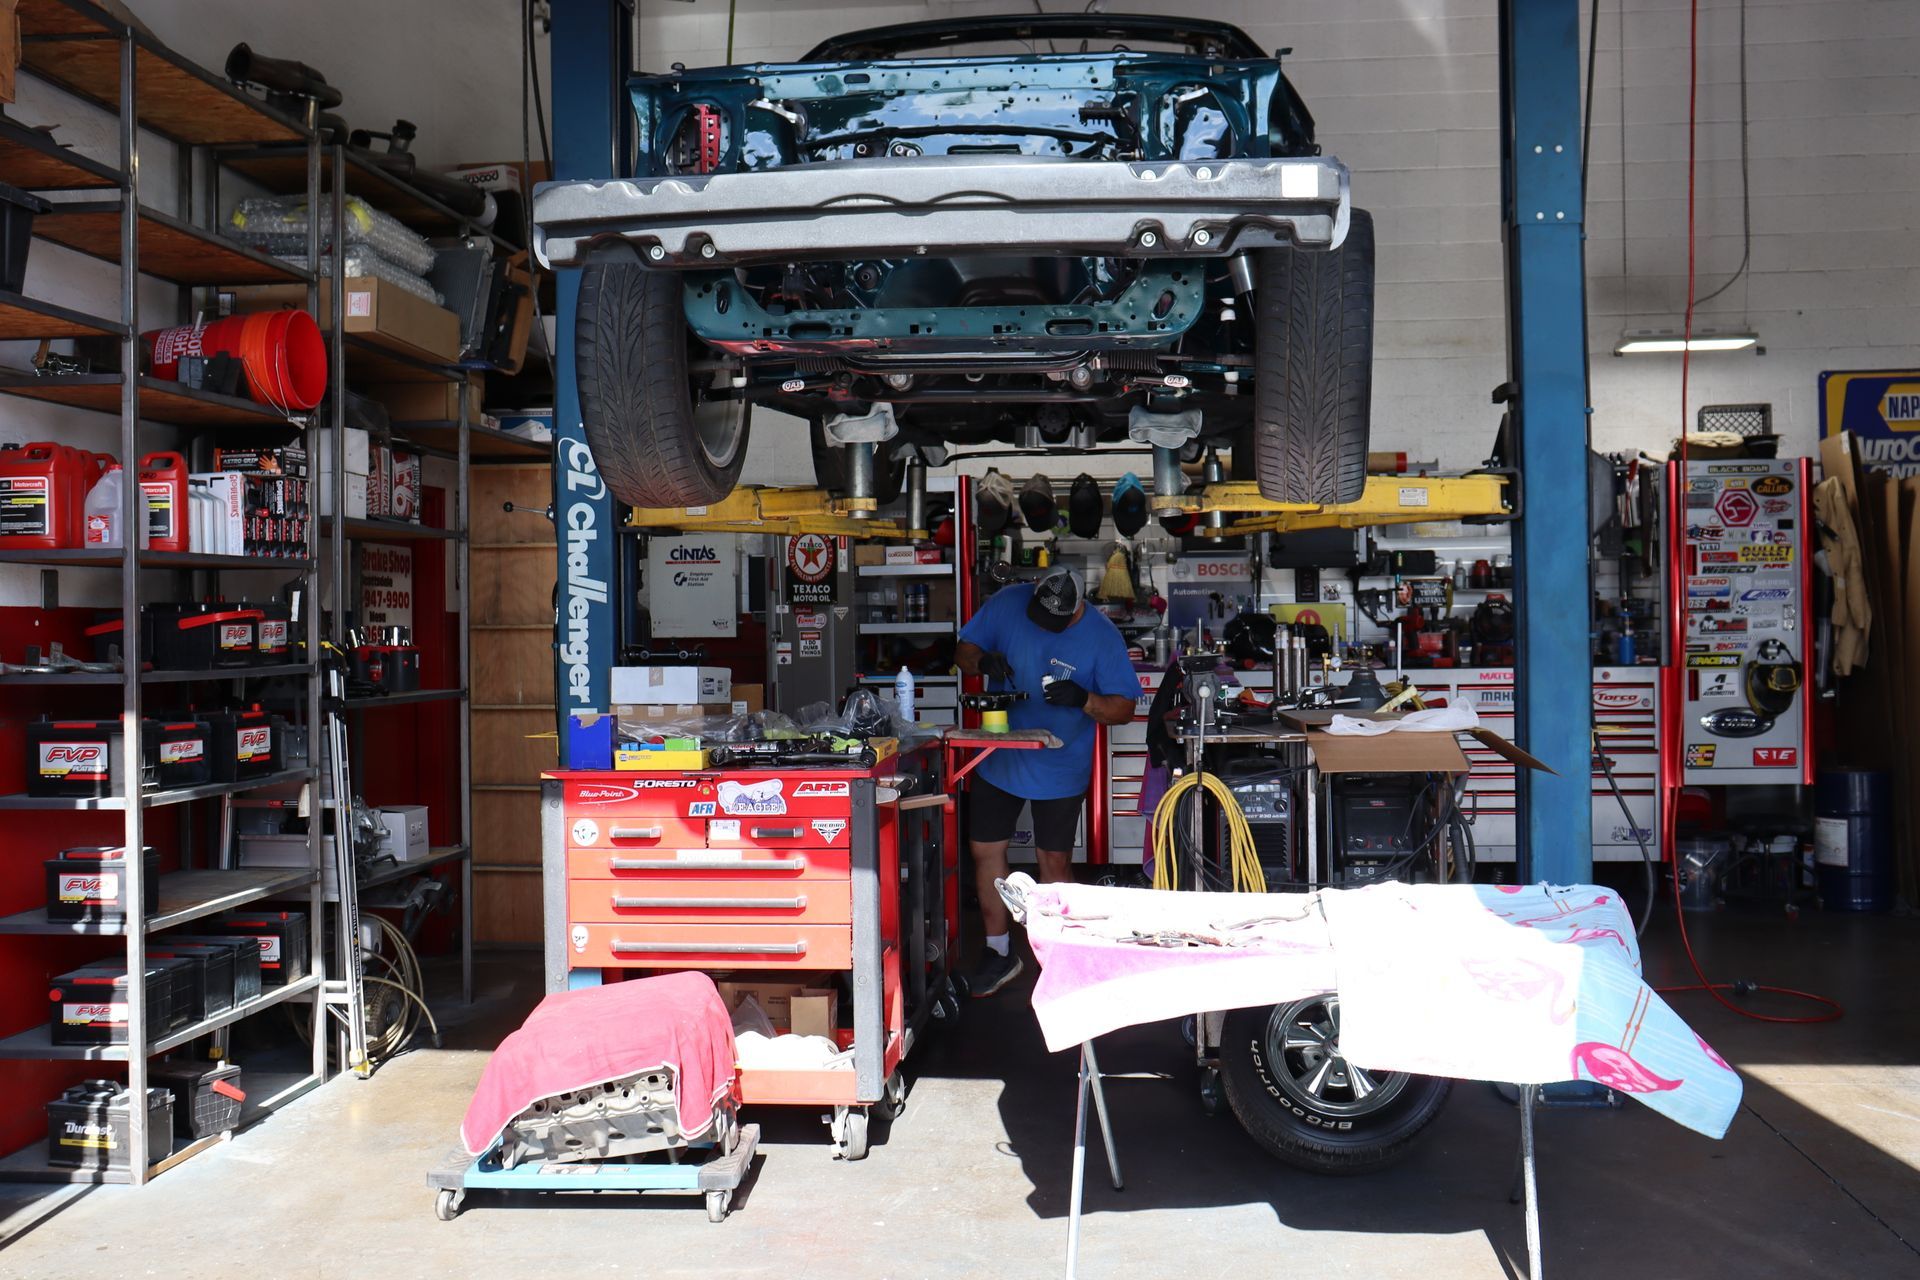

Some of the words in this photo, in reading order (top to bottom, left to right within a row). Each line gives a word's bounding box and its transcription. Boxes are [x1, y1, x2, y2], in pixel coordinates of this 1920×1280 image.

[1888, 395, 1920, 419] NAP
[1741, 546, 1792, 556] BULLET
[1197, 563, 1250, 576] BOSCH
[793, 584, 831, 594] TEXACO
[560, 502, 607, 704] Challenger
[1479, 672, 1513, 680] MATC
[1482, 692, 1513, 701] MAH
[241, 731, 267, 748] FVP
[46, 747, 101, 762] FVP
[798, 783, 847, 791] ARP
[691, 804, 714, 814] AFR
[737, 802, 778, 811] EAGLE
